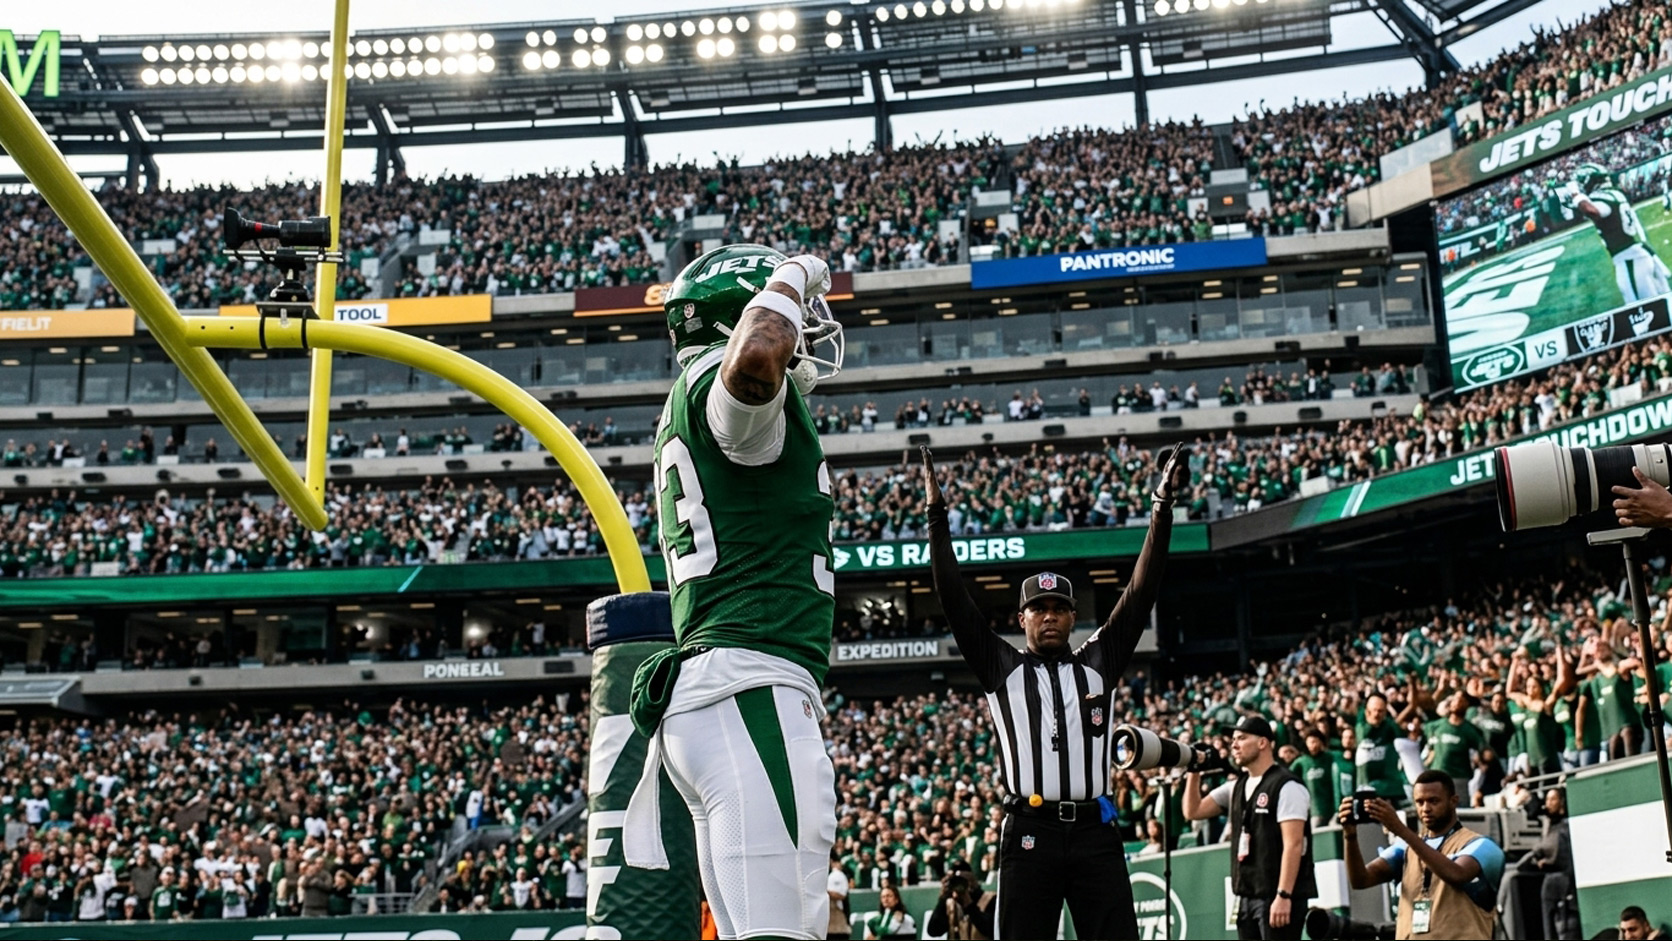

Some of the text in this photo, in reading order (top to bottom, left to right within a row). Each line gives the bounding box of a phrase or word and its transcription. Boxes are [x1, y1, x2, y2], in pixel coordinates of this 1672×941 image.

[1479, 120, 1563, 173] JETS
[1060, 248, 1175, 272] PANTRONIC
[338, 308, 382, 321] TOOL
[1535, 341, 1558, 359] VS
[857, 545, 895, 567] VS
[838, 642, 938, 660] EXPEDITION
